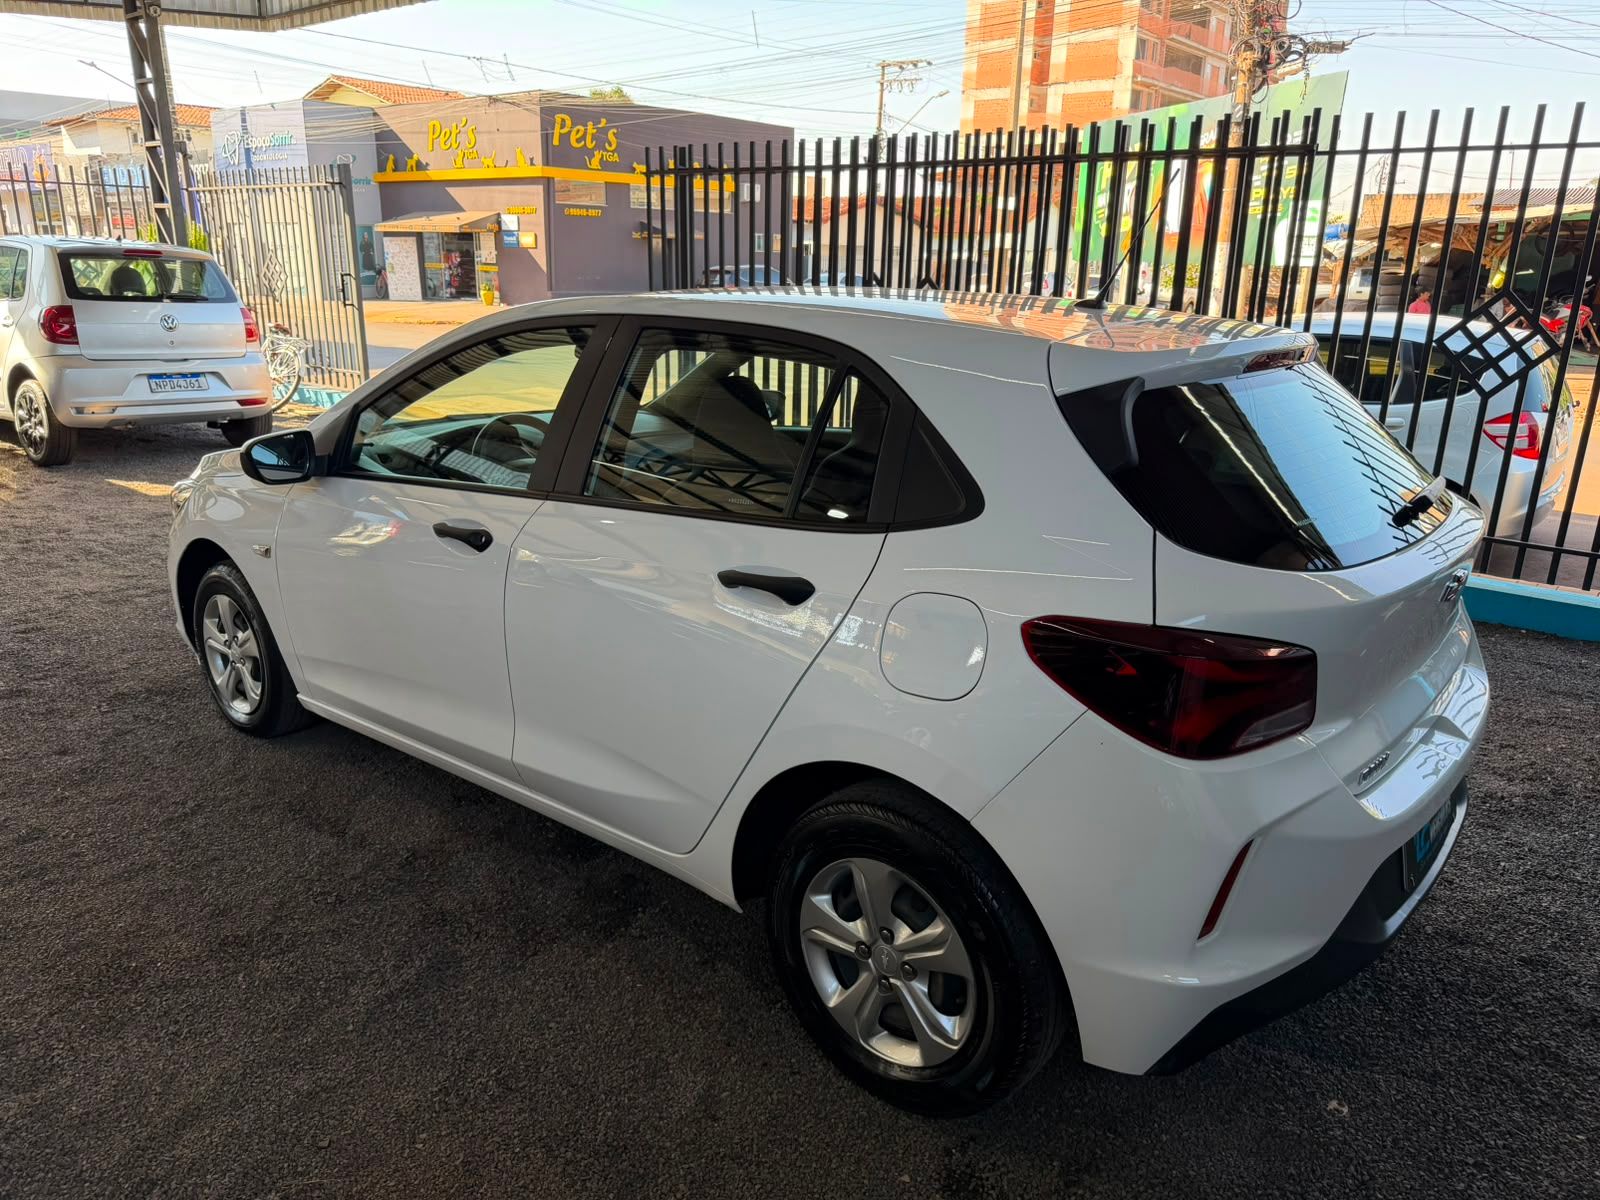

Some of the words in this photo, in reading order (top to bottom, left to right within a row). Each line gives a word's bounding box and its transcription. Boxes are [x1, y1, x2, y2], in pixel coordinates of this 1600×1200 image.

[428, 116, 477, 152] Pet's
[553, 113, 617, 151] Pet's
[465, 149, 479, 160] TGA
[603, 151, 620, 162] TGA
